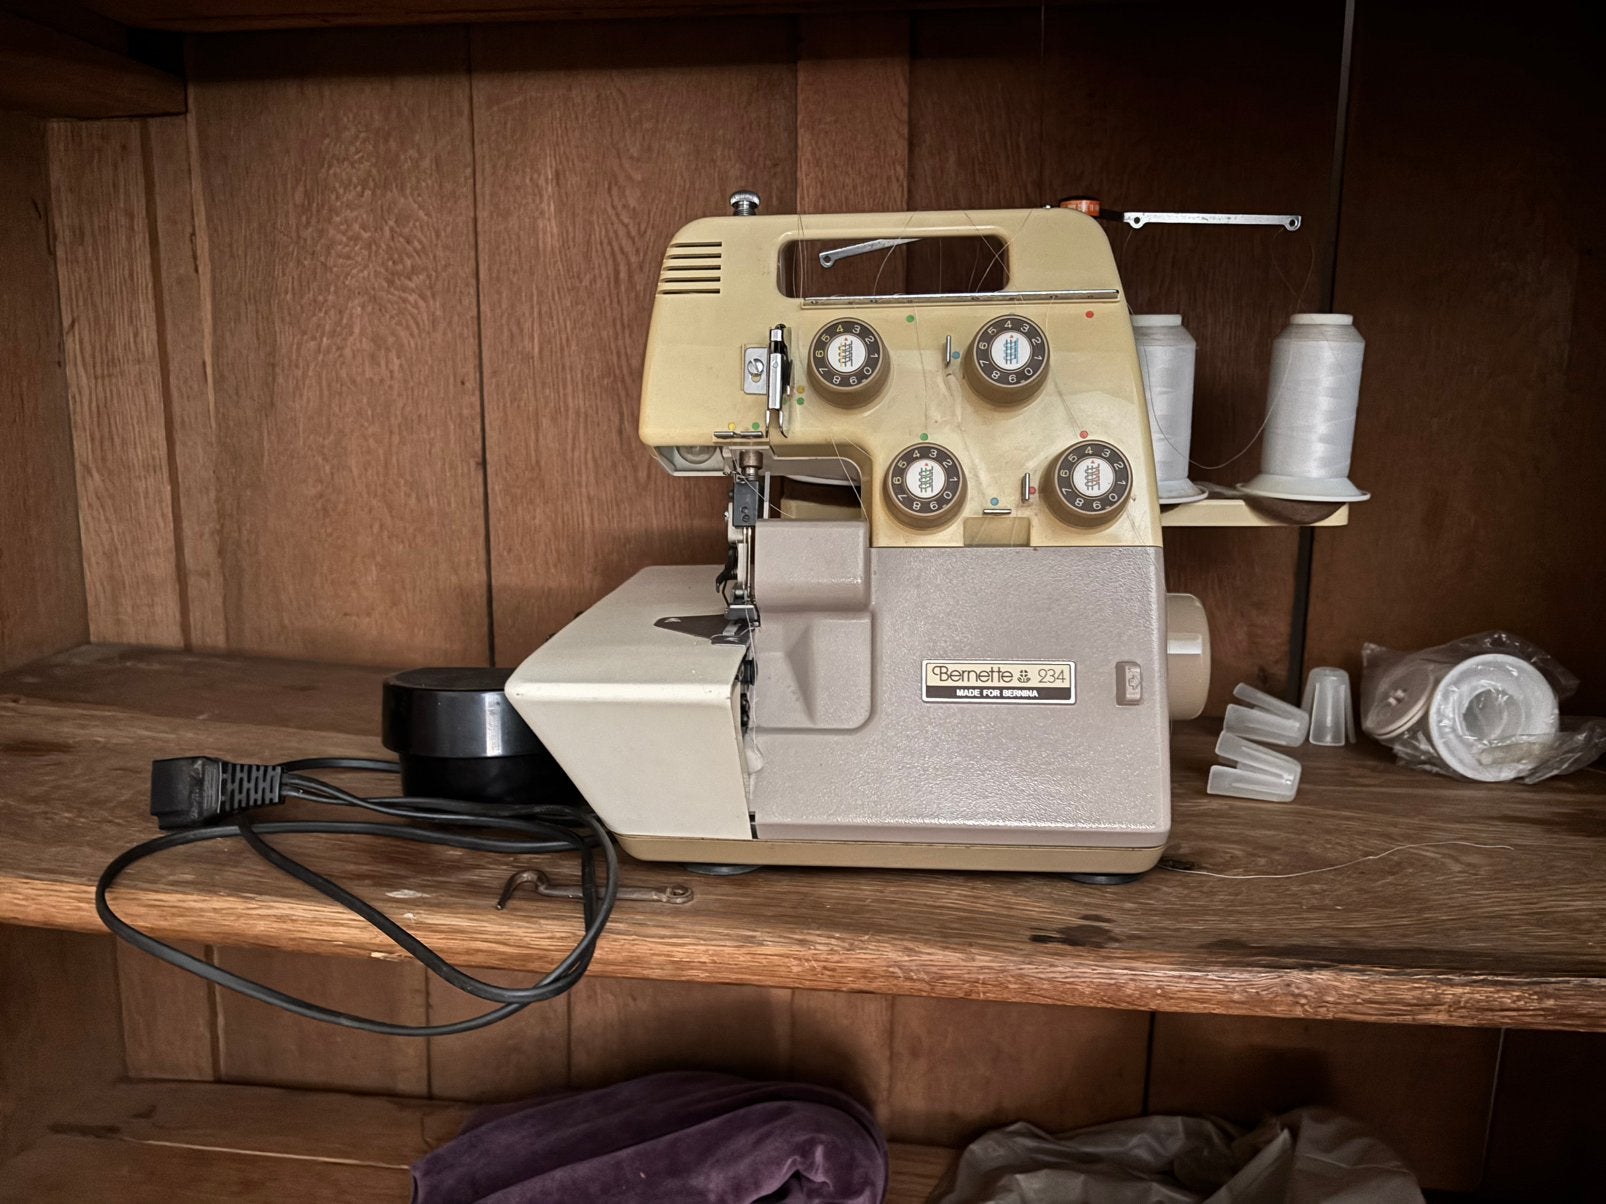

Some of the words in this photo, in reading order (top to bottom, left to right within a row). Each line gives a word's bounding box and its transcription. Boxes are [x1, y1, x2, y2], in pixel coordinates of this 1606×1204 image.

[852, 325, 860, 333] 3
[988, 327, 997, 335] 5
[1021, 324, 1029, 332] 3
[821, 334, 830, 342] 5
[865, 335, 874, 344] 2
[1031, 337, 1041, 345] 2
[864, 367, 871, 375] 0
[991, 371, 1000, 379] 8
[833, 376, 840, 384] 8
[913, 450, 920, 458] 4
[929, 450, 937, 458] 3
[1085, 446, 1093, 454] 4
[1102, 449, 1110, 457] 3
[1068, 454, 1077, 462] 5
[898, 460, 907, 468] 5
[943, 460, 952, 468] 2
[1114, 462, 1124, 470] 2
[943, 491, 952, 499] 0
[1109, 493, 1118, 501] 0
[913, 502, 921, 510] 8
[1075, 498, 1084, 507] 8
[932, 665, 1013, 683] Bernette
[1038, 668, 1066, 683] 234
[956, 689, 980, 697] MADE
[983, 689, 1000, 697] FOR
[1002, 689, 1038, 697] BERNINA
